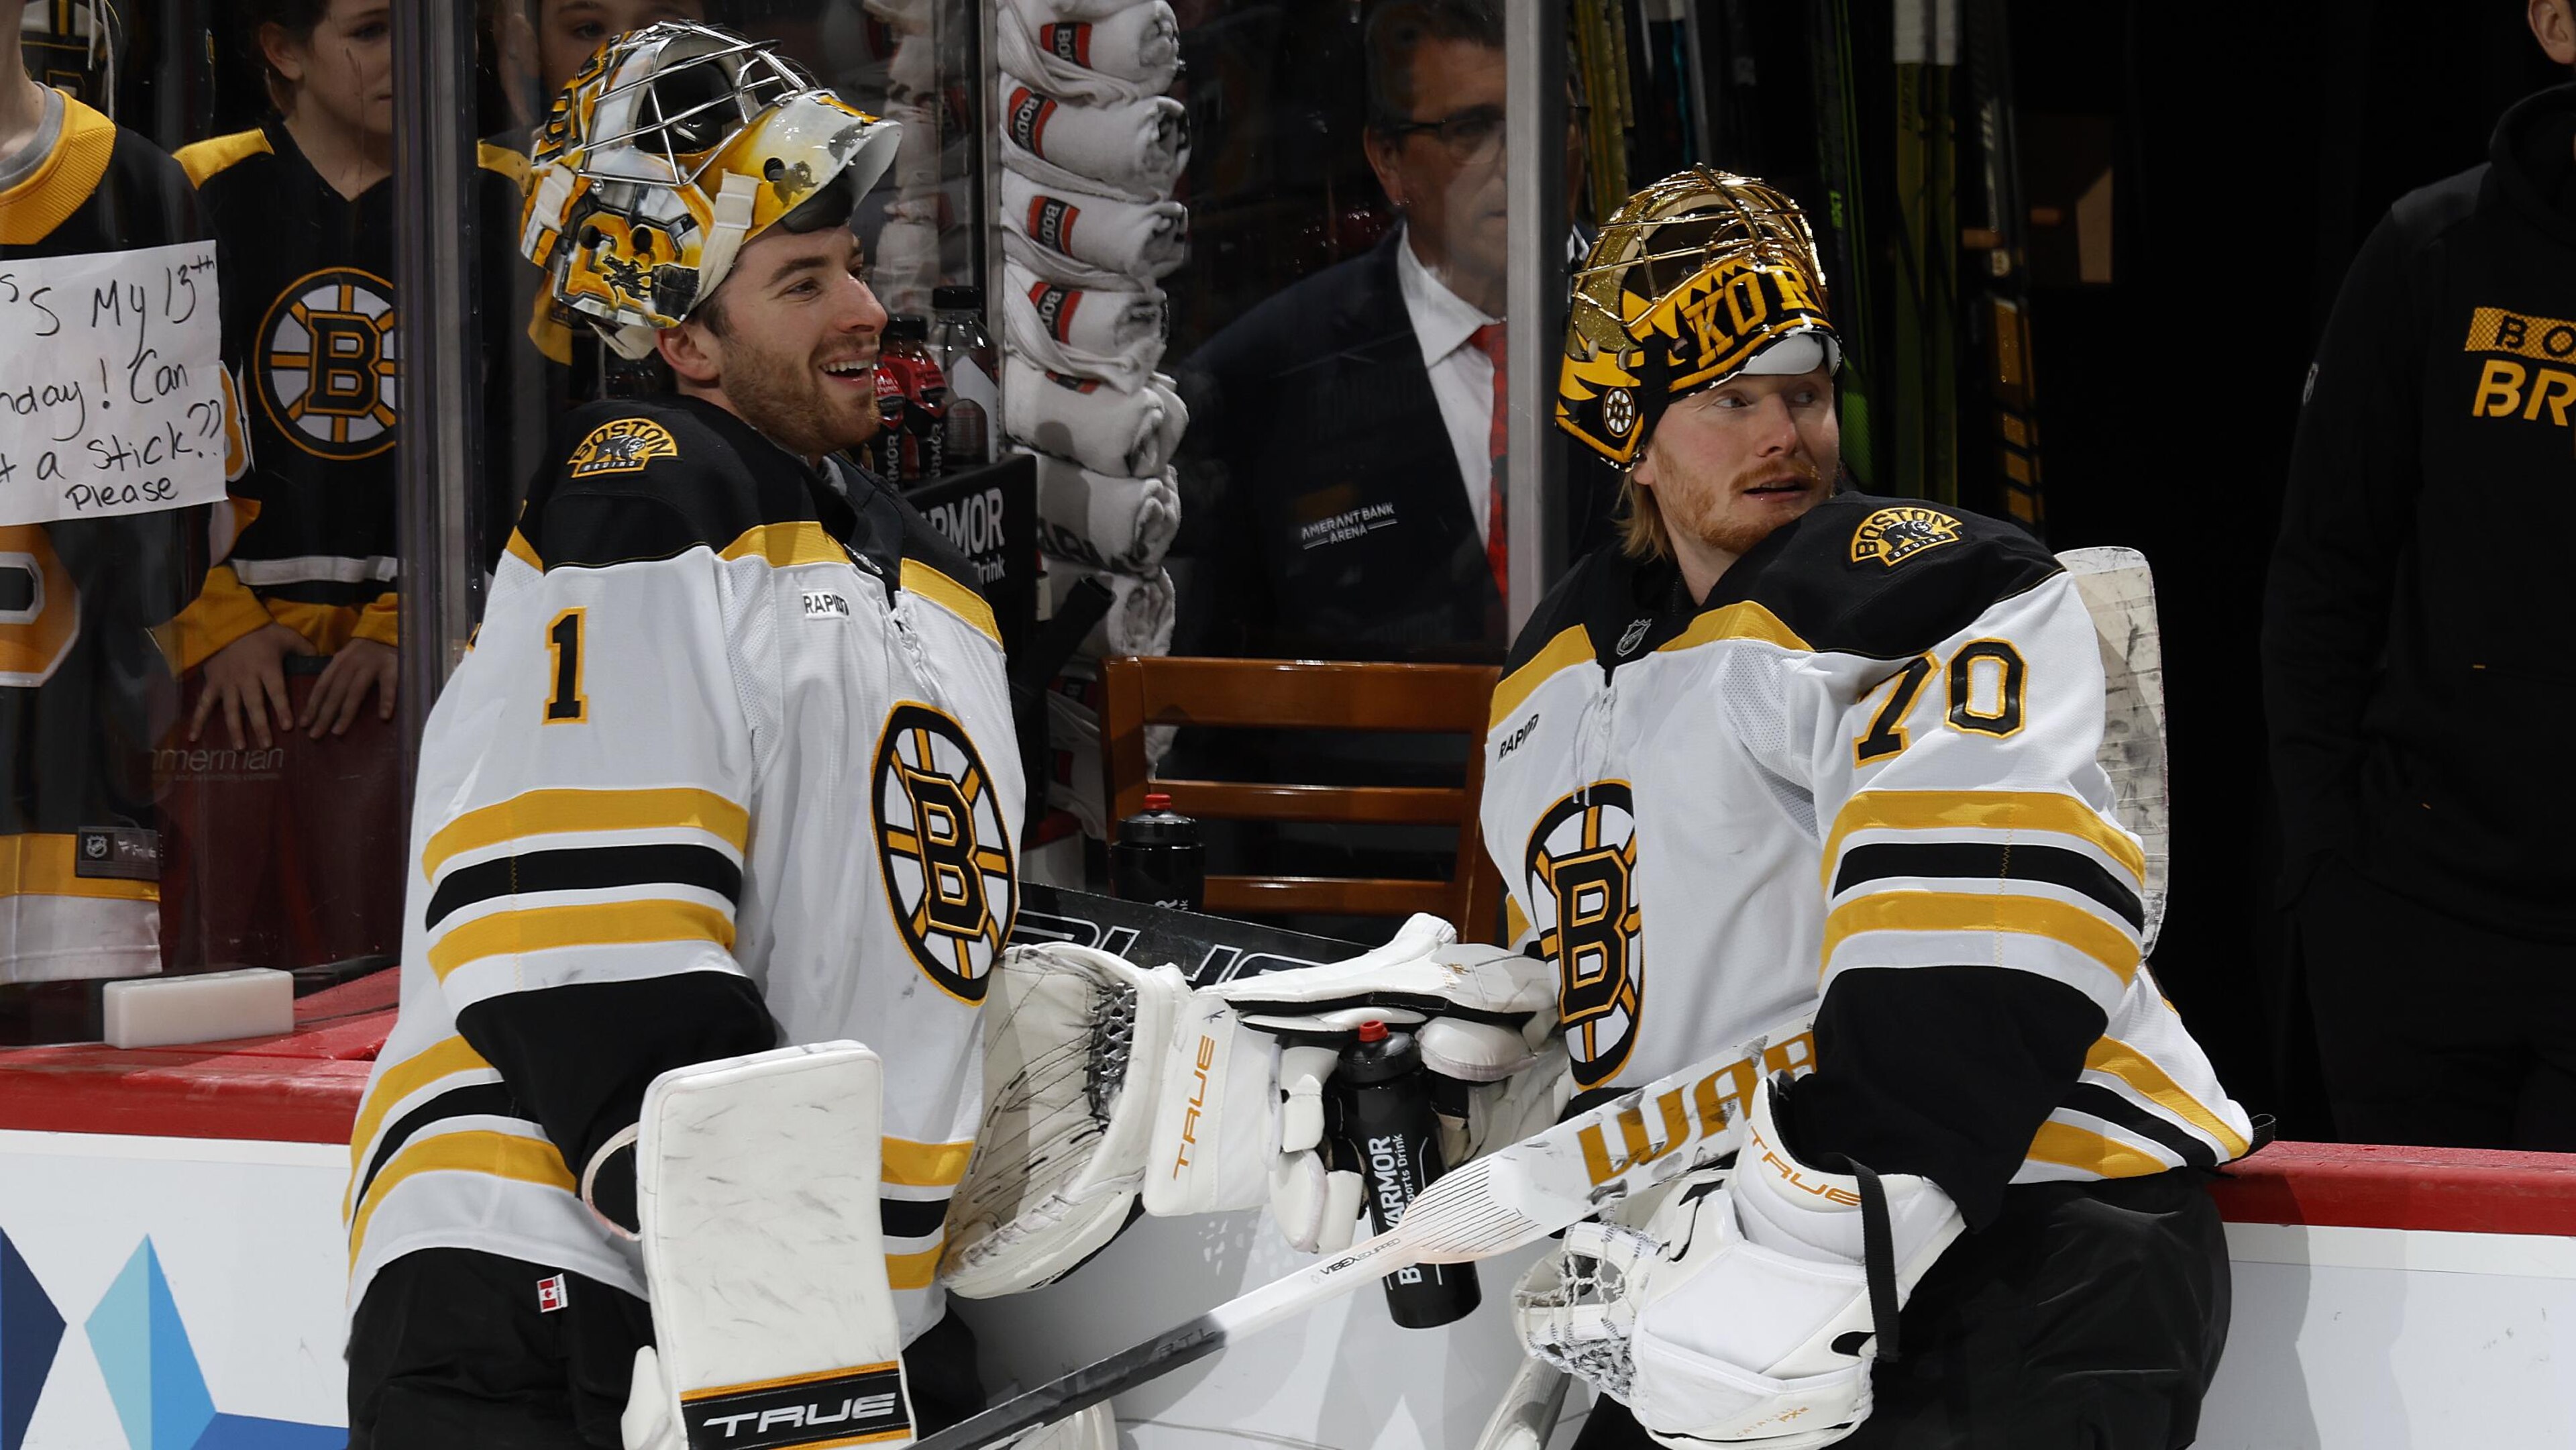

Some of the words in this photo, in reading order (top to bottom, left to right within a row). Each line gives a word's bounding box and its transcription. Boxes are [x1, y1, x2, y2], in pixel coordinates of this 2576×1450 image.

[91, 279, 145, 370] My
[2495, 315, 2576, 357] BO
[130, 349, 189, 405] Can
[2473, 359, 2576, 427] BR
[37, 452, 66, 480] a
[570, 421, 674, 460] BOSTON
[920, 487, 1006, 558] RMOR
[1301, 509, 1361, 540] AMERANT
[1361, 502, 1395, 521] BANK
[1330, 522, 1368, 544] ARENA
[1856, 509, 1958, 558] BOSTON
[542, 607, 588, 725] 1
[1852, 637, 2029, 770] 70
[1173, 1035, 1216, 1181] TRUE
[1393, 1133, 1408, 1168] Drink
[1751, 1125, 1862, 1206] TRUE
[702, 1392, 896, 1437] TRUE
